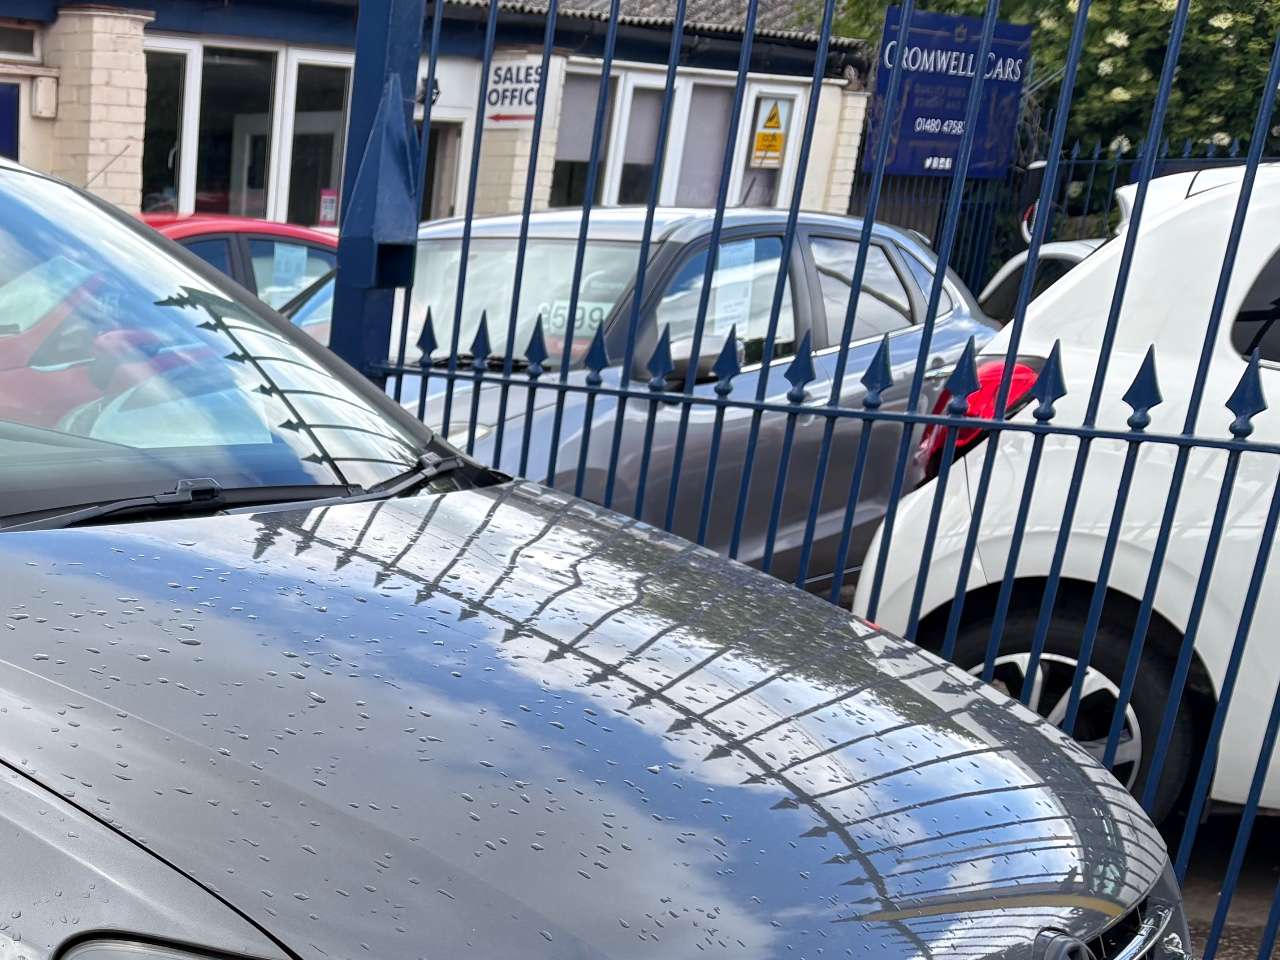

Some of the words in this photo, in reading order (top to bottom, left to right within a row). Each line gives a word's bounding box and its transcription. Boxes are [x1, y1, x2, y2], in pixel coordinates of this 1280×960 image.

[884, 40, 975, 77] CROMWELL
[493, 65, 542, 85] SALES
[488, 87, 536, 106] OFFIC
[941, 120, 966, 135] 4758
